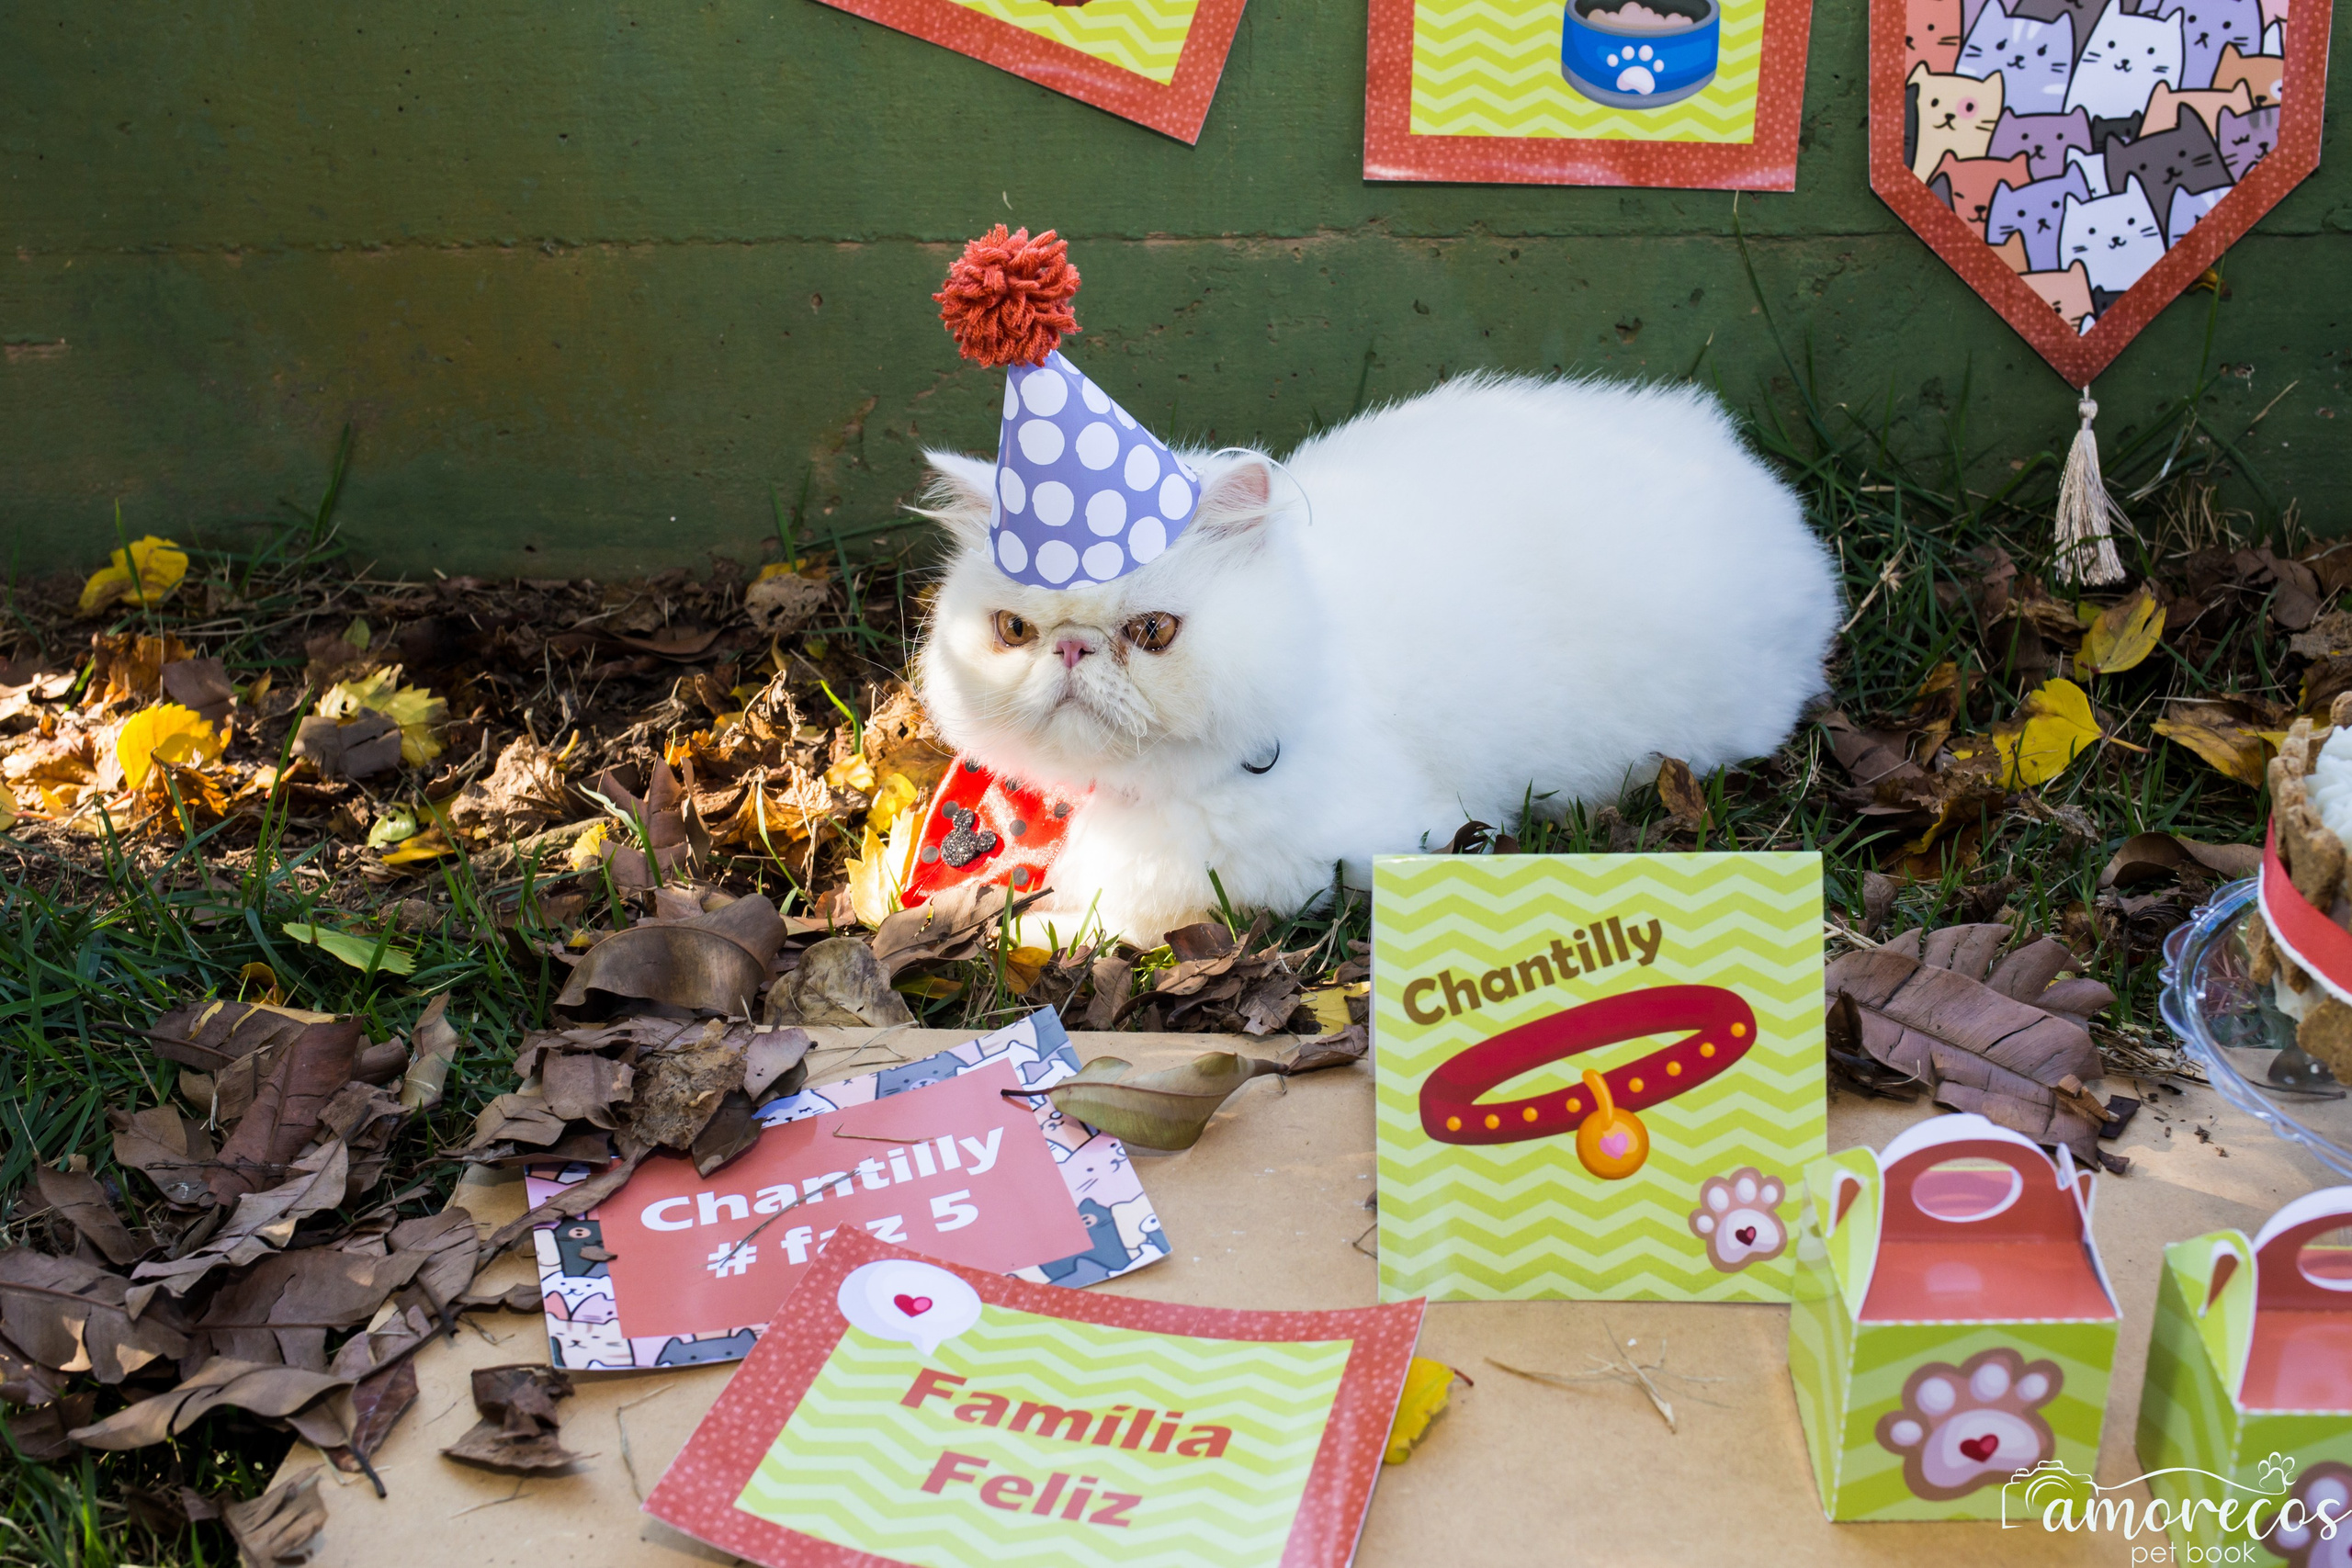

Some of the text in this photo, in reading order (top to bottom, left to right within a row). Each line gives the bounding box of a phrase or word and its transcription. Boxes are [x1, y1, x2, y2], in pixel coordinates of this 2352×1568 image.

[1403, 915, 1663, 1026] Chantilly
[640, 1126, 1004, 1232] Chantilly
[929, 1189, 979, 1233] 5
[899, 1367, 1233, 1459] Família
[920, 1450, 1144, 1528] Feliz
